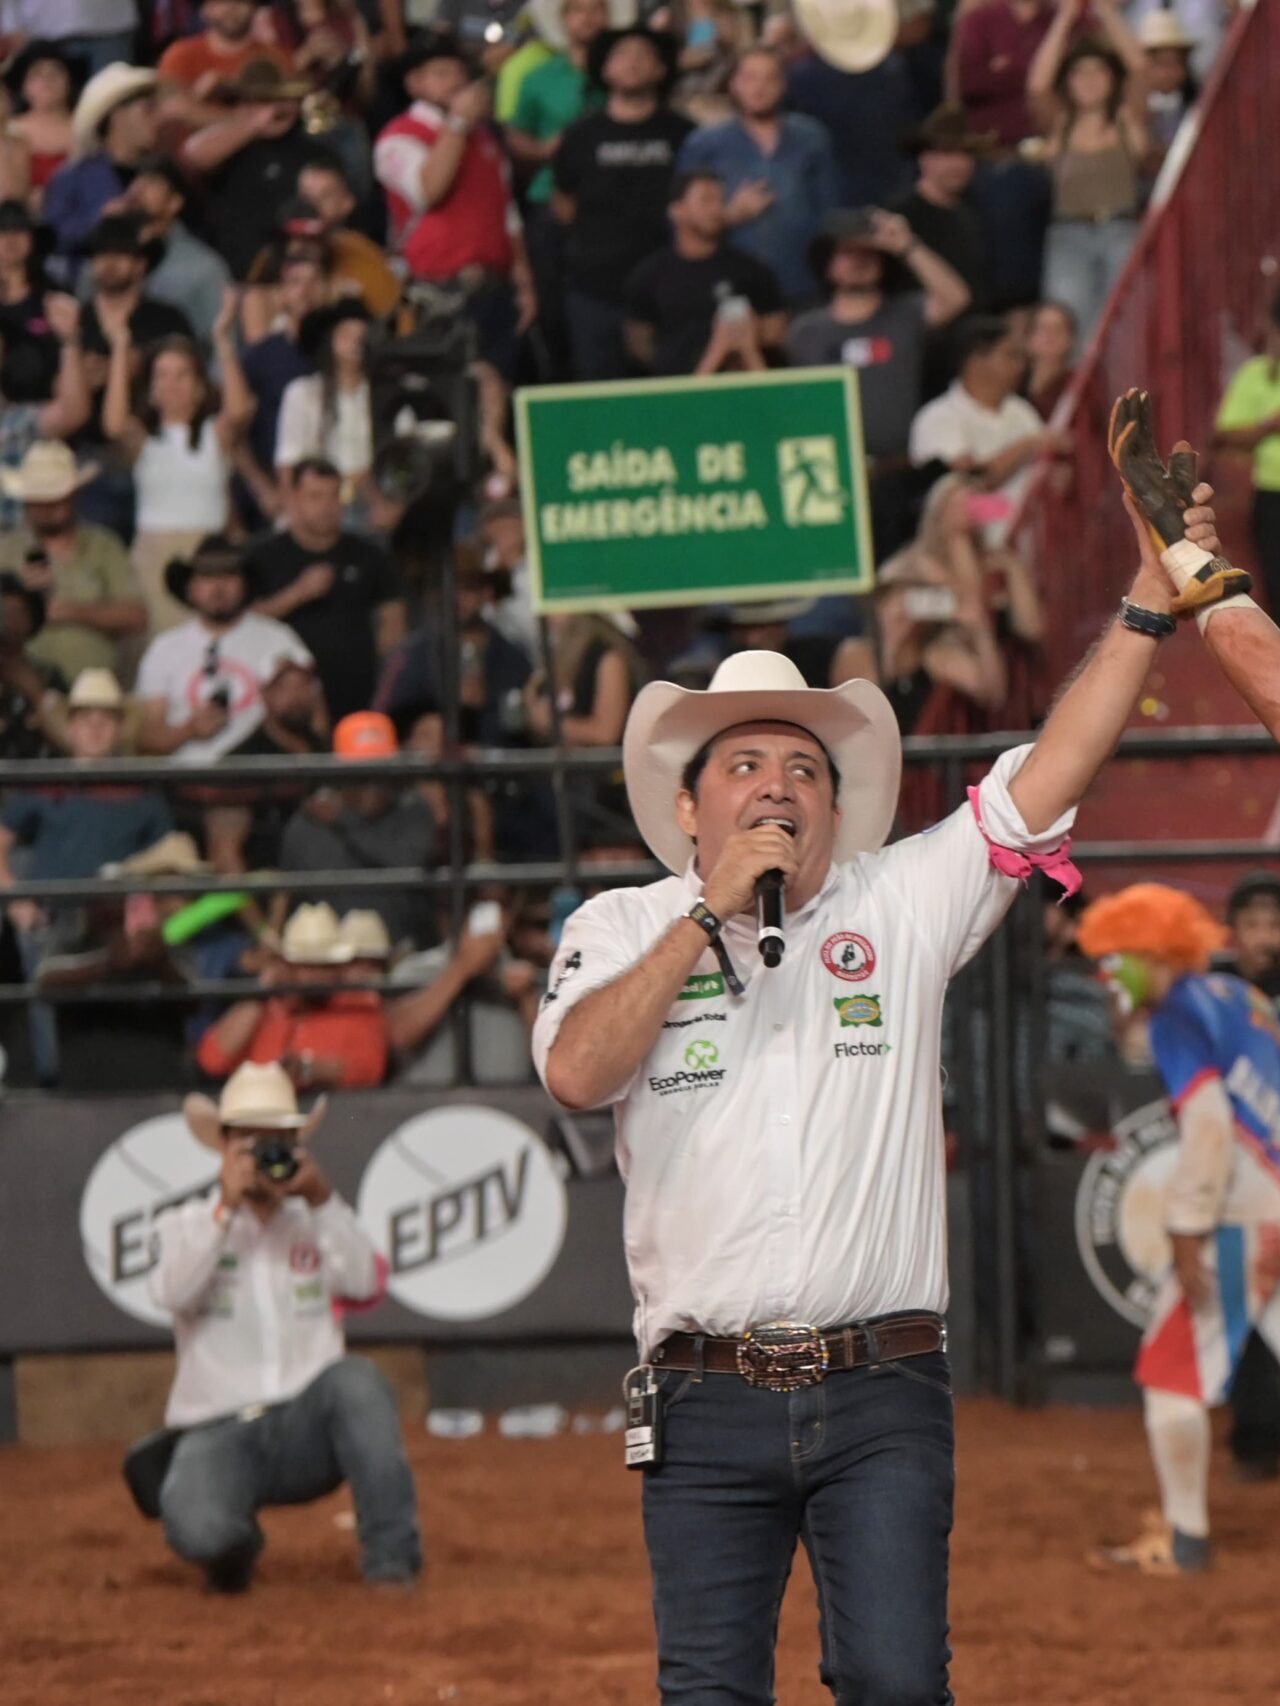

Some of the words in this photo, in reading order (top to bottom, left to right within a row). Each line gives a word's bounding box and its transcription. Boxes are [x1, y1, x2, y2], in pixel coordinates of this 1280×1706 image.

[567, 440, 678, 493] SAÍDA
[696, 442, 744, 484] DE
[541, 483, 768, 543] EMERGÊNCIA
[834, 1042, 883, 1058] Fictor
[649, 1069, 727, 1091] EcoPower
[390, 1146, 532, 1276] EPTV
